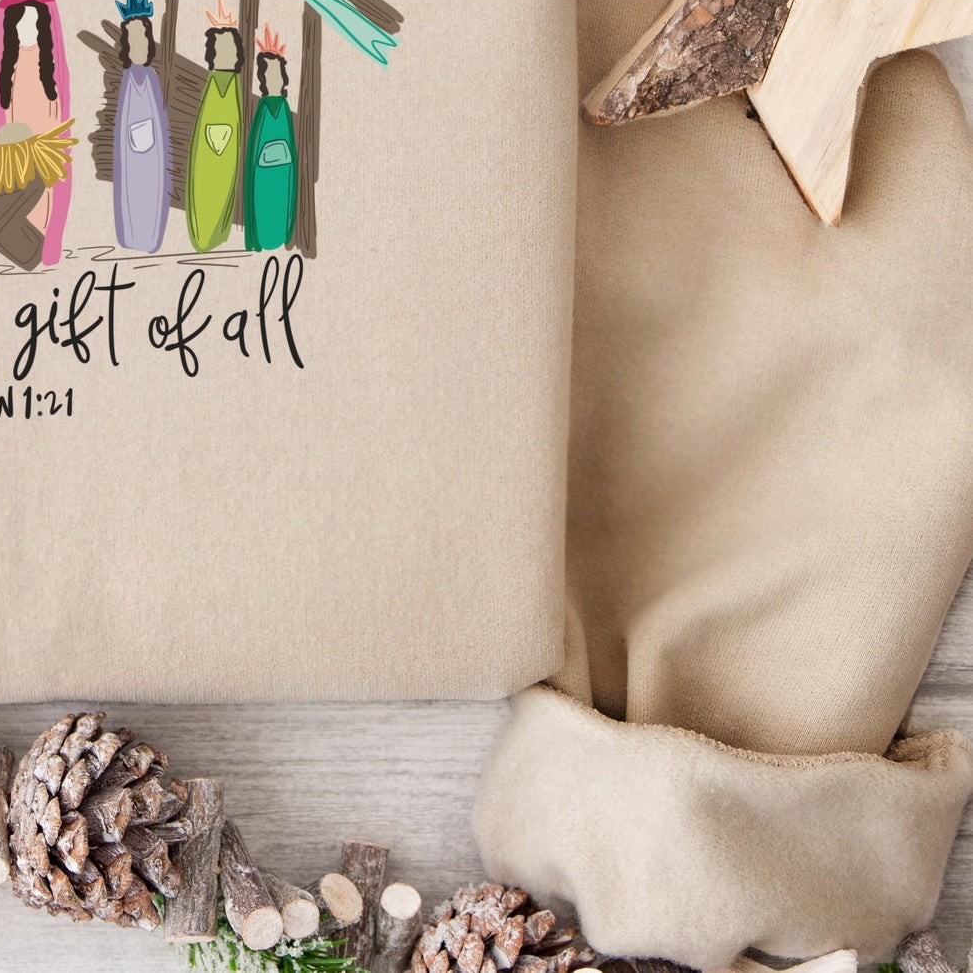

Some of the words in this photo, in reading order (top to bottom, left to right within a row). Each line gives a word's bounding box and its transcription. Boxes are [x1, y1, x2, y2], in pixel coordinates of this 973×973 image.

[12, 262, 136, 381] gift
[148, 268, 213, 378] of
[222, 253, 305, 369] all
[22, 385, 74, 420] 1:21
